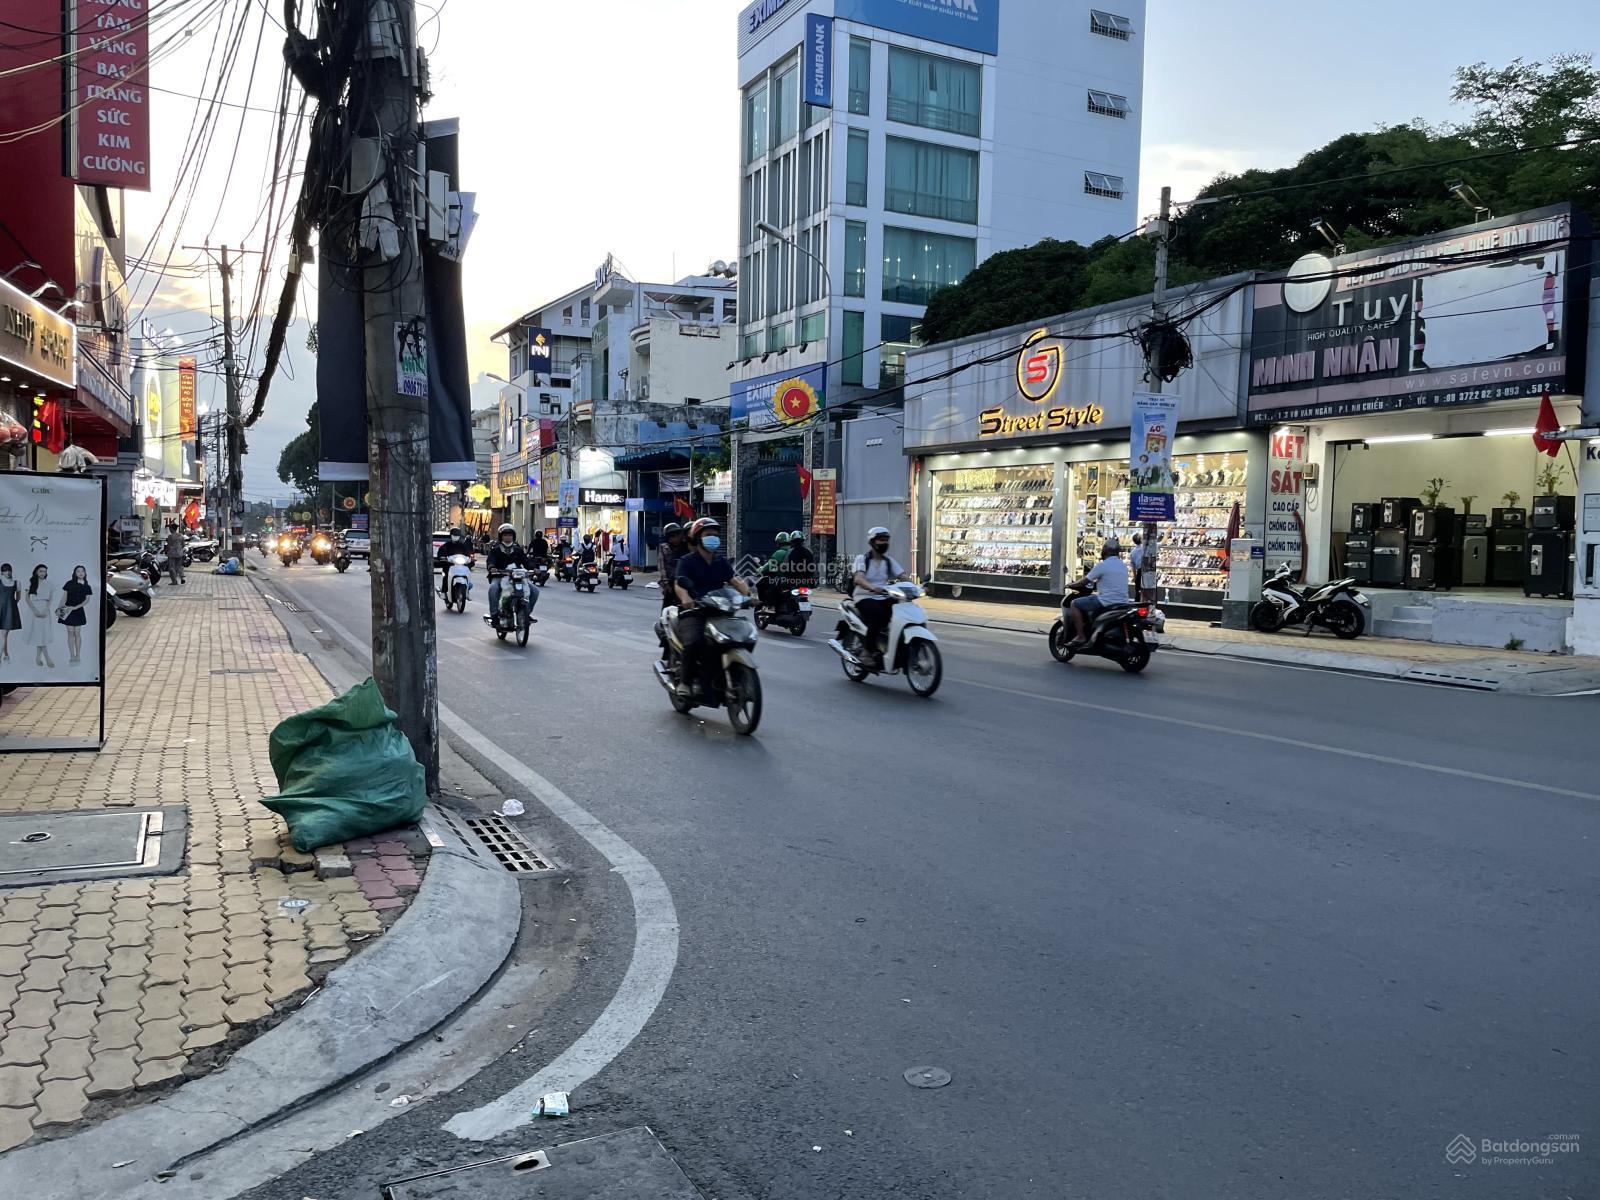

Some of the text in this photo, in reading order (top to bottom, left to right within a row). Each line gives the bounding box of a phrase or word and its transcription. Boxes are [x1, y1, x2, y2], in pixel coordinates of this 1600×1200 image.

[95, 14, 131, 31] TÂM
[815, 23, 825, 97] EXIMBANK
[86, 84, 142, 104] TRANG
[97, 107, 131, 126] SỨC
[98, 133, 131, 149] KIM
[82, 154, 145, 175] CƯƠNG
[1307, 321, 1391, 342] HIGH QUALITY SAFE
[531, 345, 549, 358] PNJ
[1253, 335, 1400, 388] MINH NHÂN
[979, 402, 1103, 436] Street Style
[585, 490, 624, 503] Hames
[1273, 501, 1286, 512] CAO
